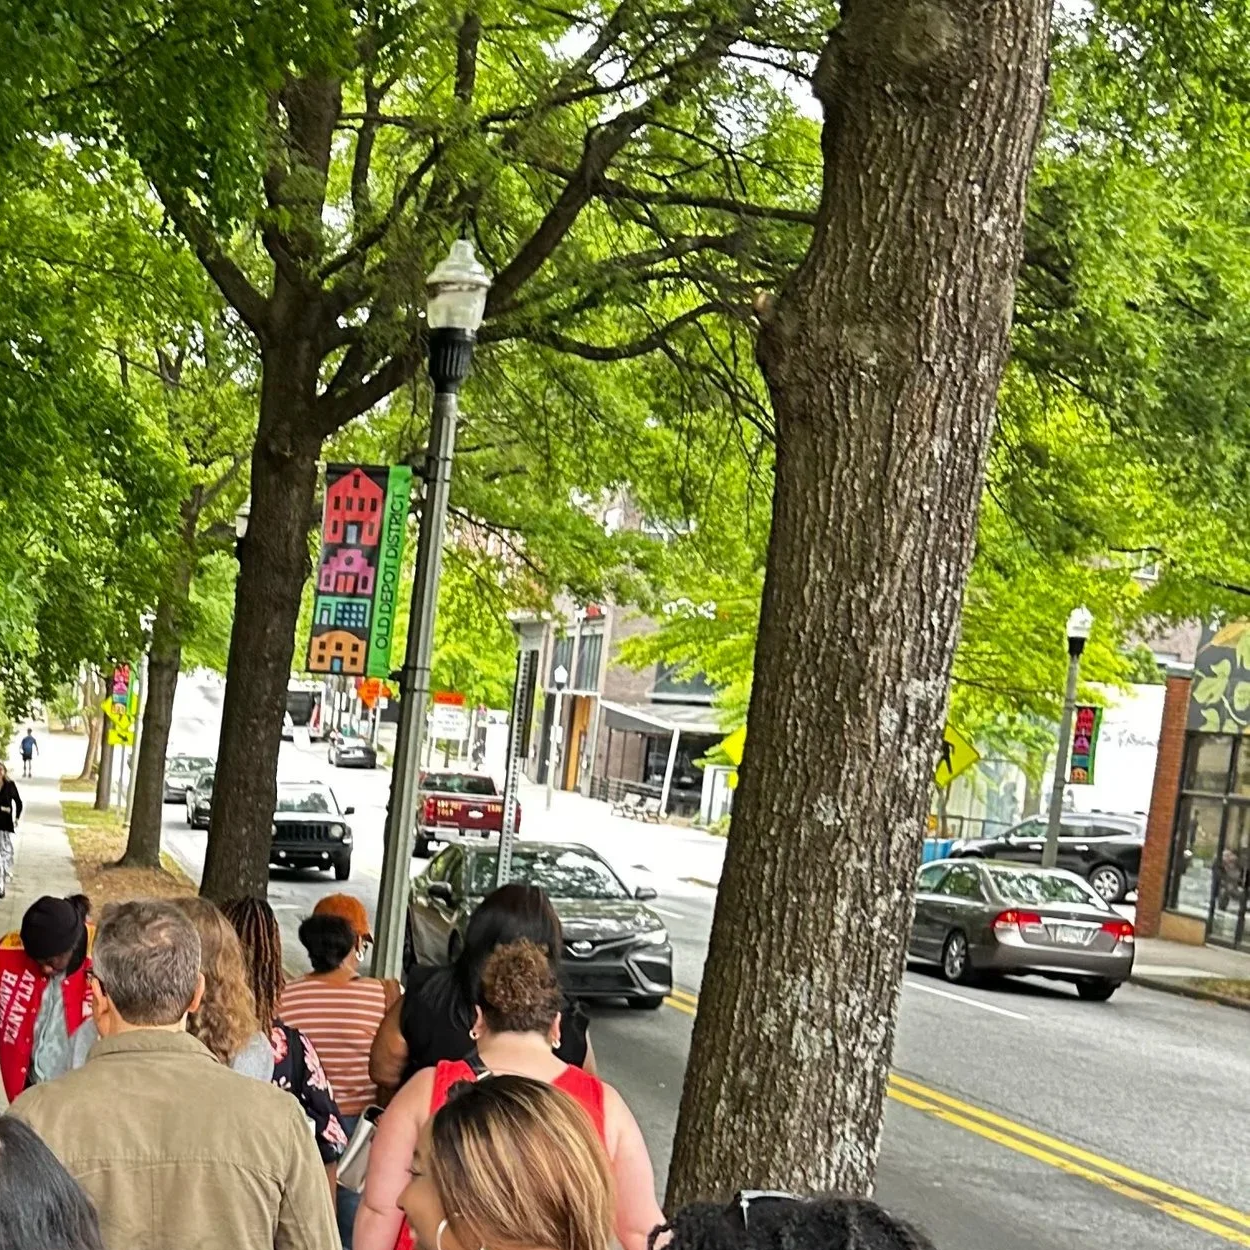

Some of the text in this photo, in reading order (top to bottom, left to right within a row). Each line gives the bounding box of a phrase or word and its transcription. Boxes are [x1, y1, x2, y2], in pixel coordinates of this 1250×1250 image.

[375, 491, 406, 650] OLD DEPOT DISTRICT
[3, 968, 36, 1046] ATLANTA
